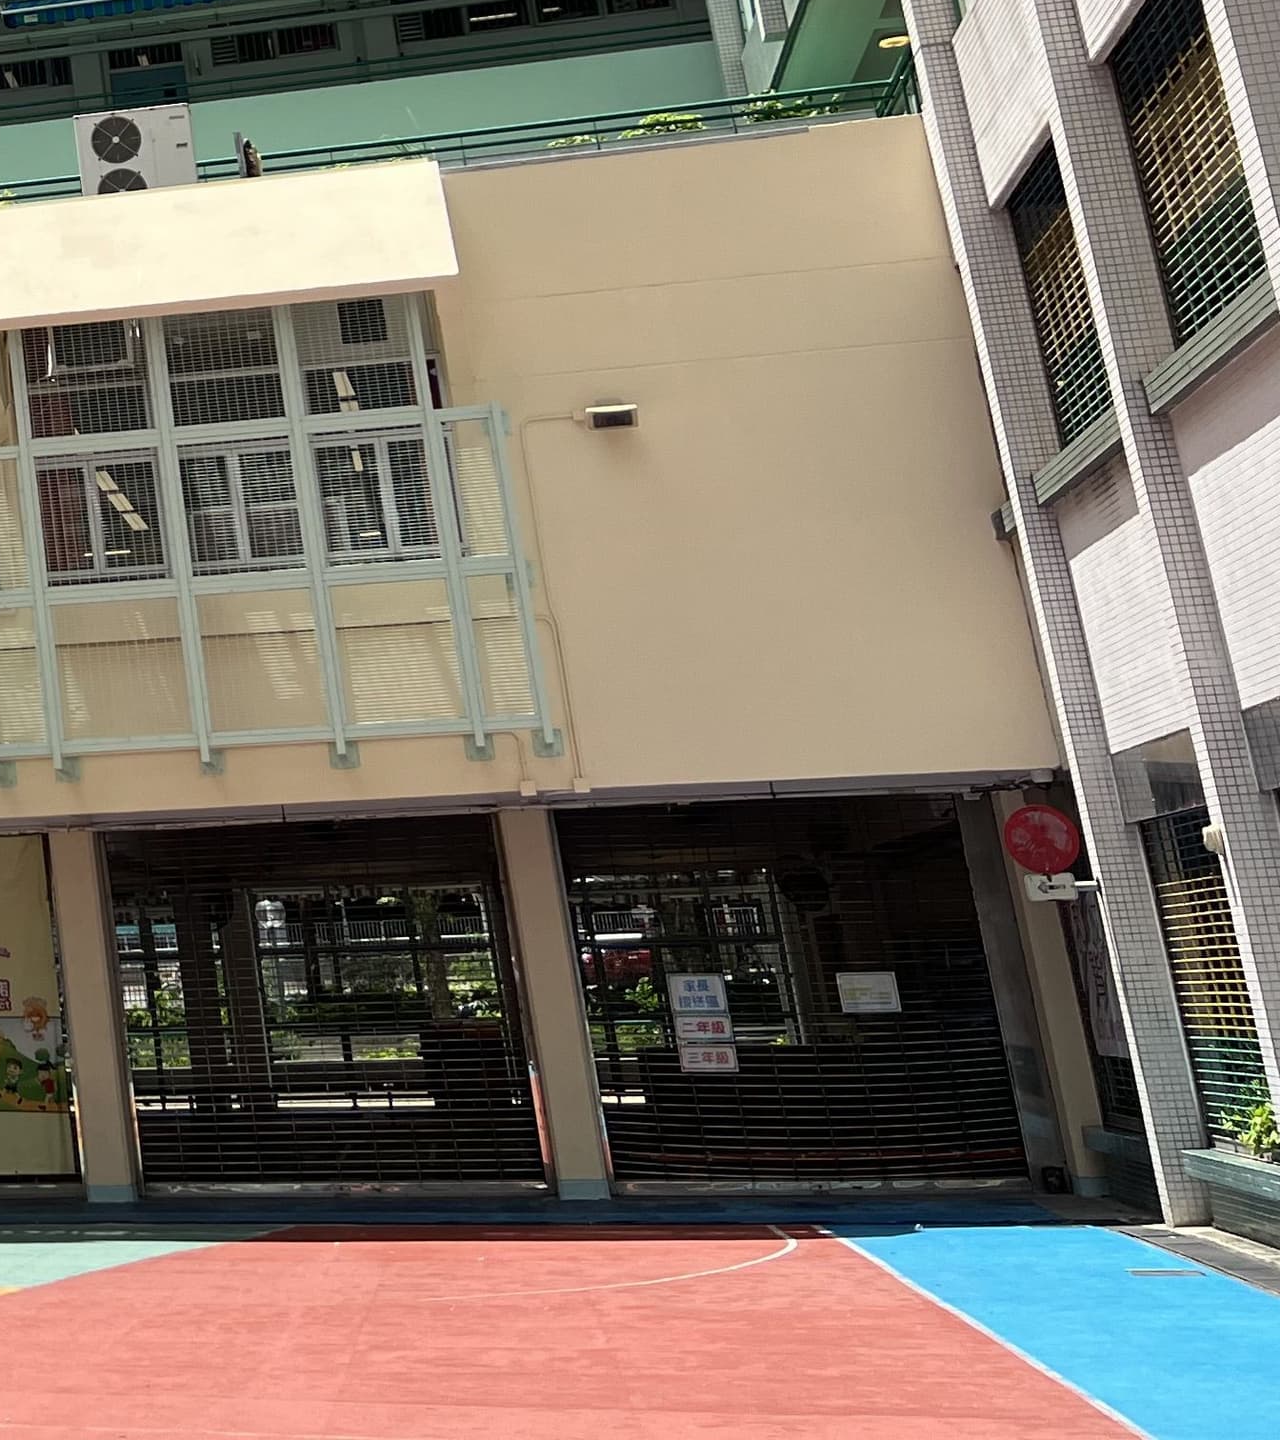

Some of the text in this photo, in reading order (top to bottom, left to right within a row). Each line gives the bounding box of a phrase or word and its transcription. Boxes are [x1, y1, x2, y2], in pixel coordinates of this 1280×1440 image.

[682, 1020, 727, 1034] 二年級
[687, 1051, 730, 1065] 三年級
